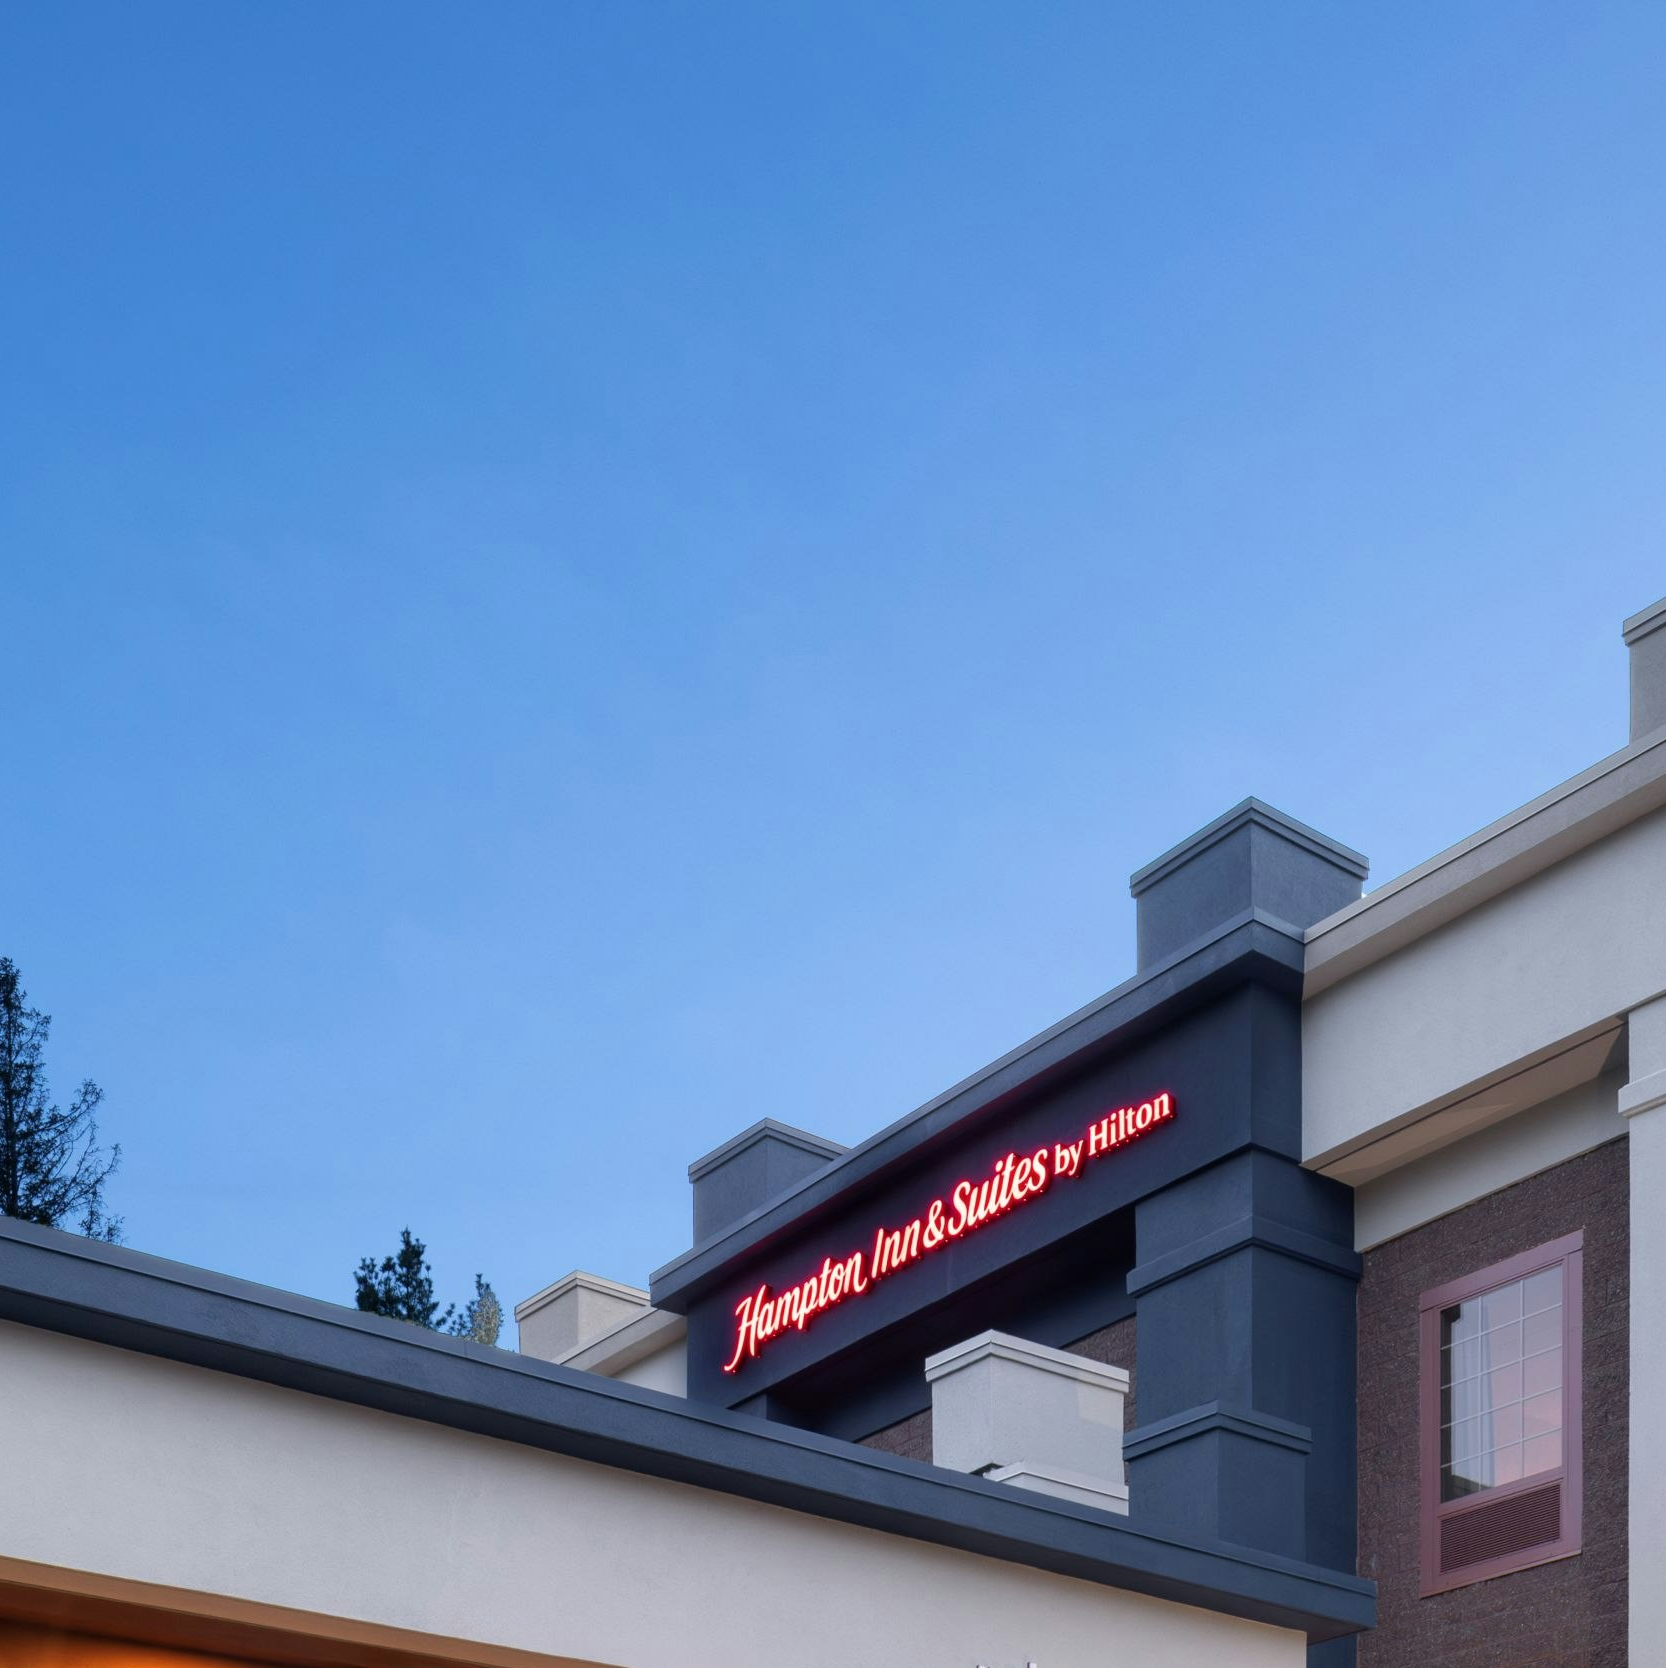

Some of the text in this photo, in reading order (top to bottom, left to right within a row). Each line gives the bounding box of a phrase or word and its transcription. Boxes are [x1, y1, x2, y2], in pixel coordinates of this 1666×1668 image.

[723, 1251, 869, 1372] Hampton
[1053, 1138, 1084, 1177] by
[1088, 1092, 1172, 1157] Hilton
